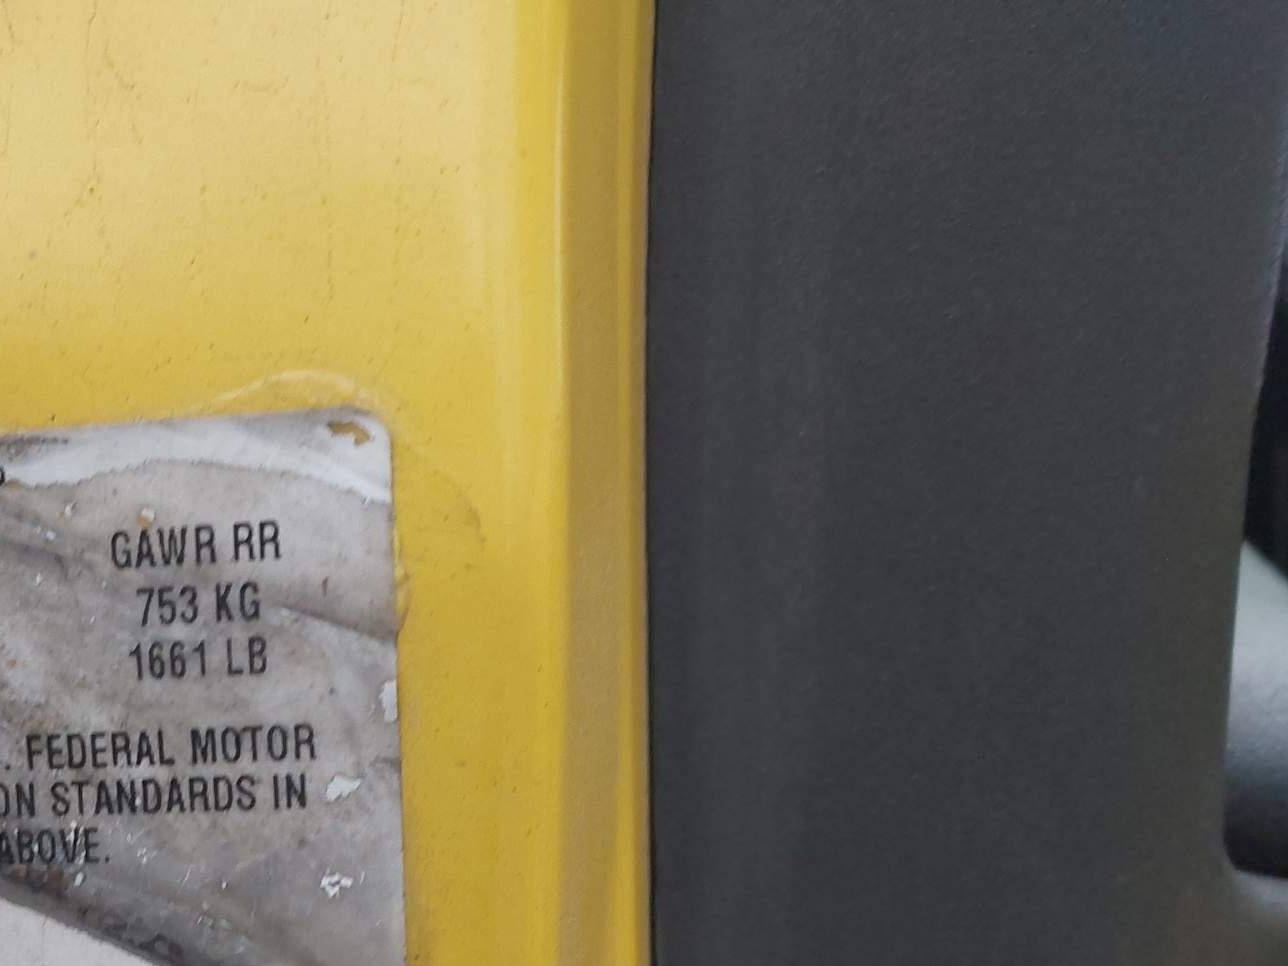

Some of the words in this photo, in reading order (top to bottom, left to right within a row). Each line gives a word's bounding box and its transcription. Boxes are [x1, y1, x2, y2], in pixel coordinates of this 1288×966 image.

[111, 525, 218, 569] GAWR
[234, 521, 280, 561] RR
[137, 588, 199, 627] 753
[215, 583, 261, 621] KG
[128, 641, 207, 680] 1661
[226, 637, 266, 676] LB
[26, 730, 175, 771] FEDERAL
[190, 724, 317, 764] MOTOR
[50, 776, 257, 814] STANDARDS
[272, 773, 308, 809] IN
